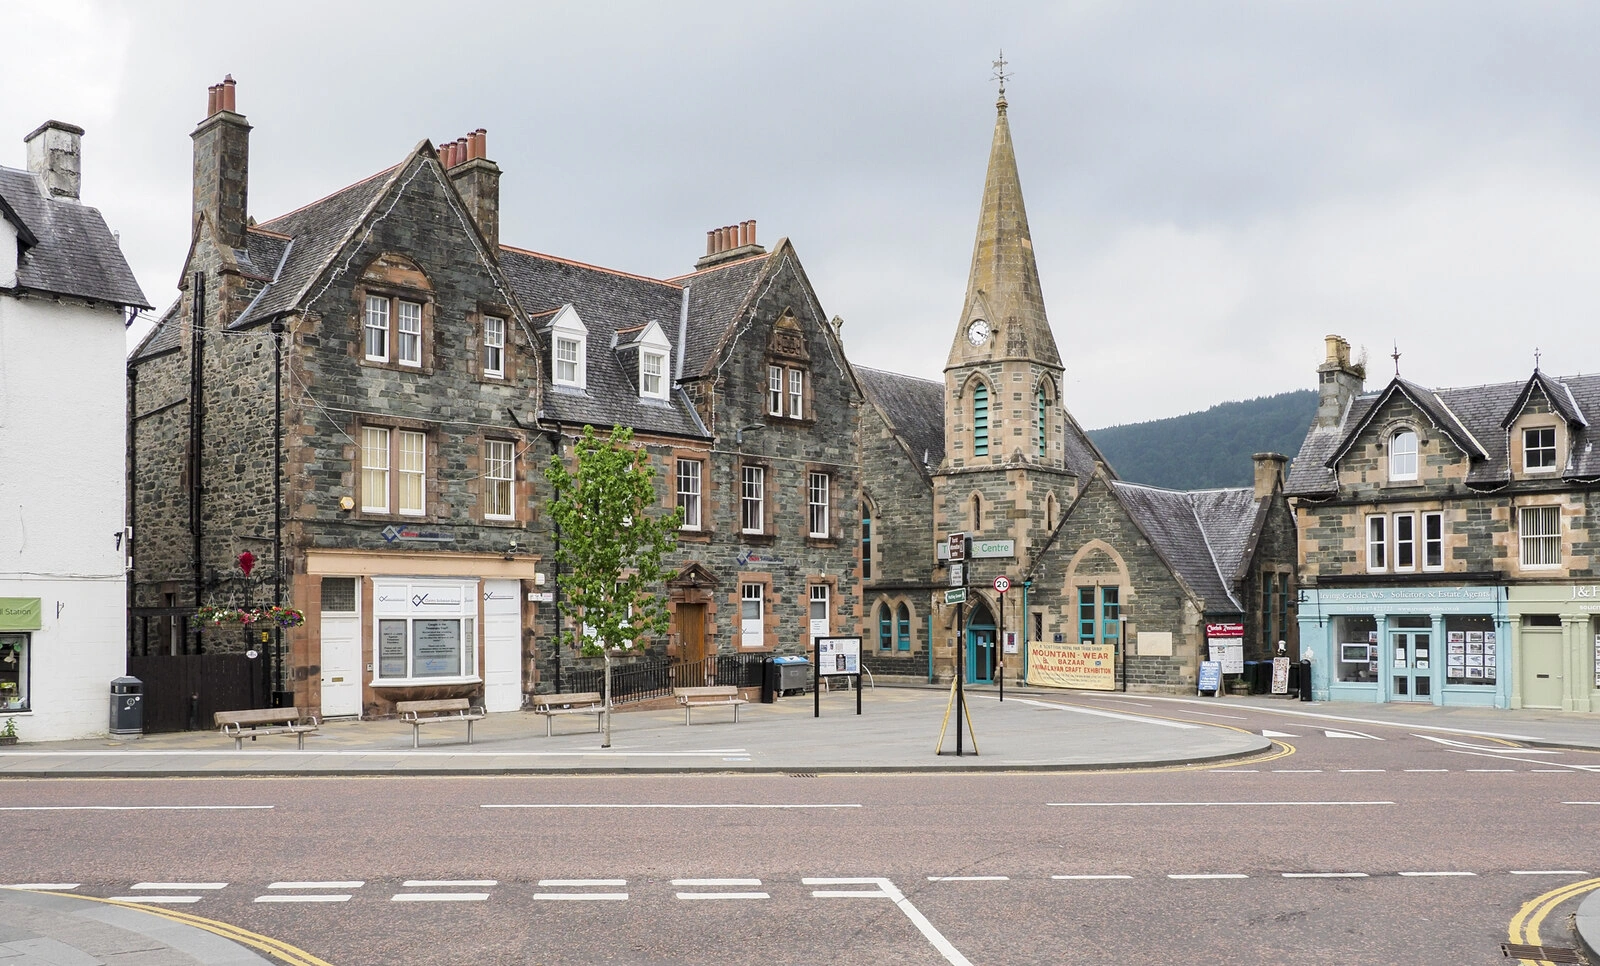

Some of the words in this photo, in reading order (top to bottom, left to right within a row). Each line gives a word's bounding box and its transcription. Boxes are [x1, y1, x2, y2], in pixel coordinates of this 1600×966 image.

[981, 543, 1009, 553] Centre
[996, 580, 1008, 588] 20
[1319, 591, 1341, 600] Irving
[1342, 591, 1369, 599] Geddes
[1370, 590, 1386, 599] W.S.
[1391, 589, 1426, 598] Solicitors
[1427, 590, 1436, 598] &
[1438, 589, 1461, 598] Estate
[1463, 589, 1490, 599] Agents
[1032, 649, 1076, 659] MOUNTAIN
[1082, 651, 1109, 660] WEAR
[1058, 658, 1085, 666] BAZAAR
[1065, 666, 1081, 674] CRAFT
[1083, 667, 1111, 675] EXHIBITION
